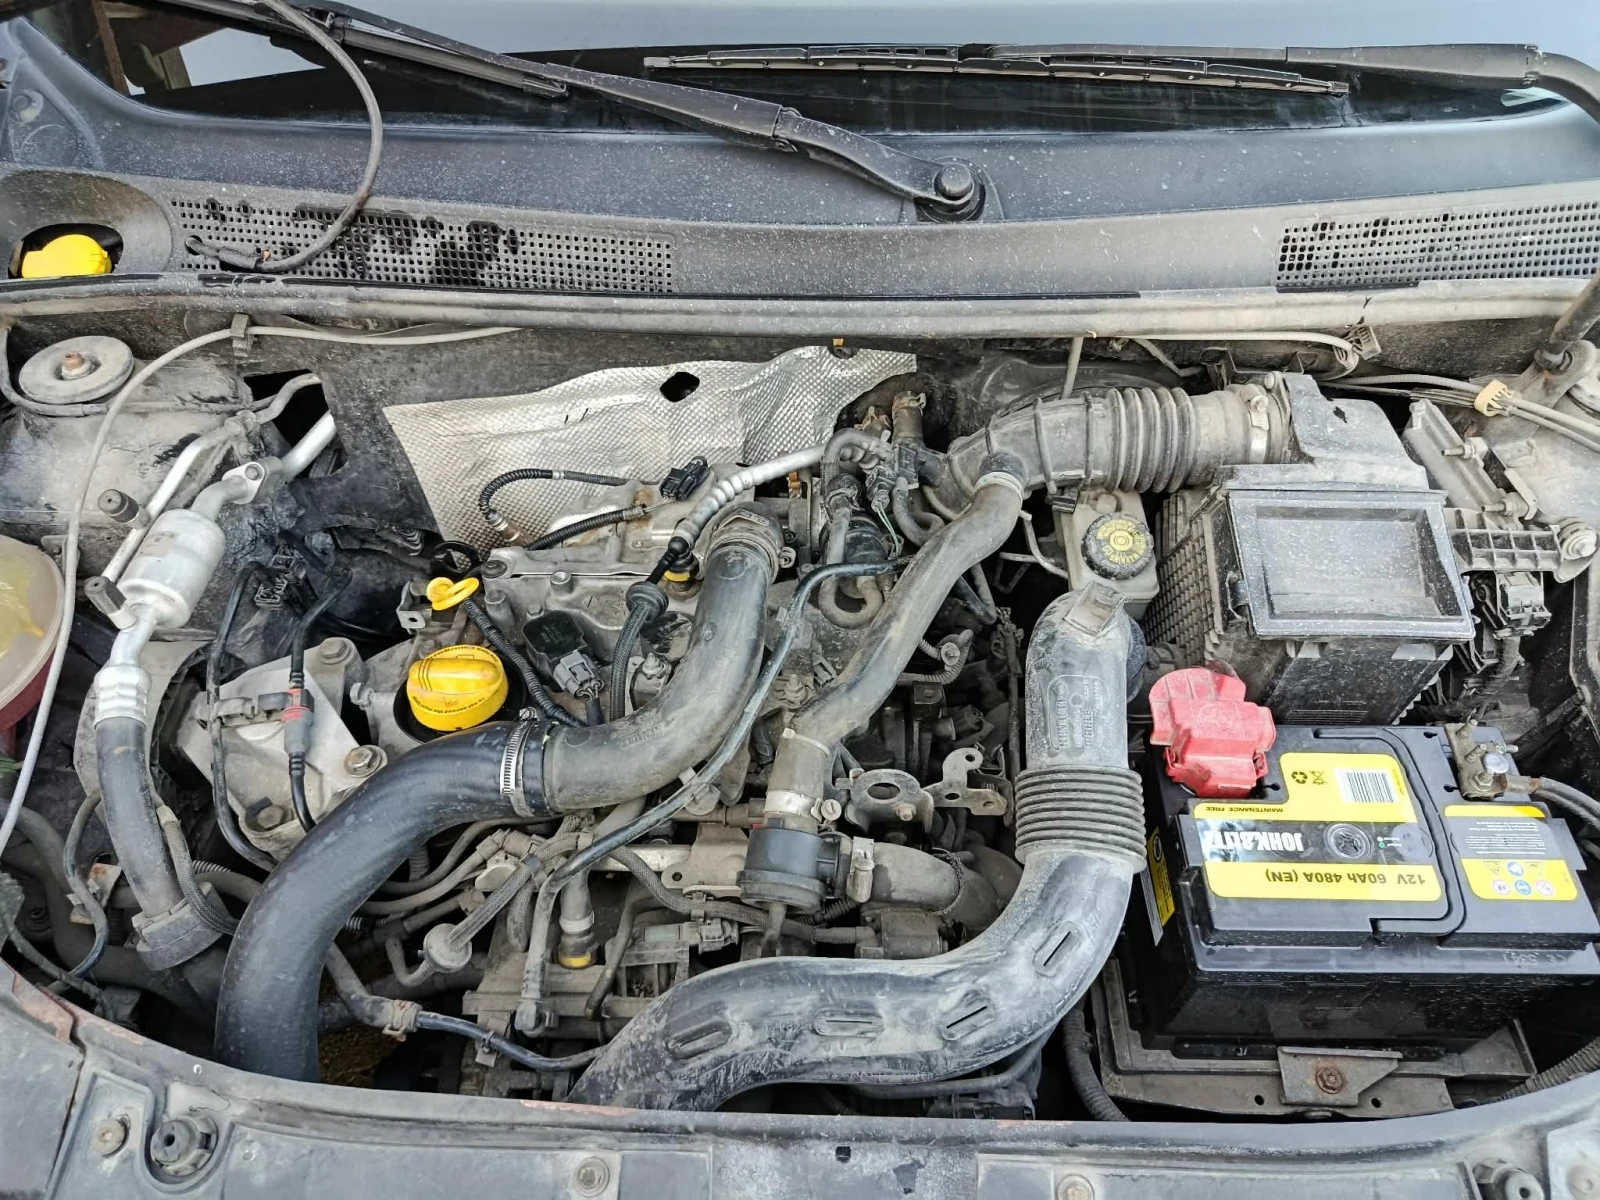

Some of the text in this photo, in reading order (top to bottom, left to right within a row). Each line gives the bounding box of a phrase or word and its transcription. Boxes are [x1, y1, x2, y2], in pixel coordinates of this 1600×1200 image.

[1265, 868, 1426, 885] 12V 60Ah 480A (EN)
